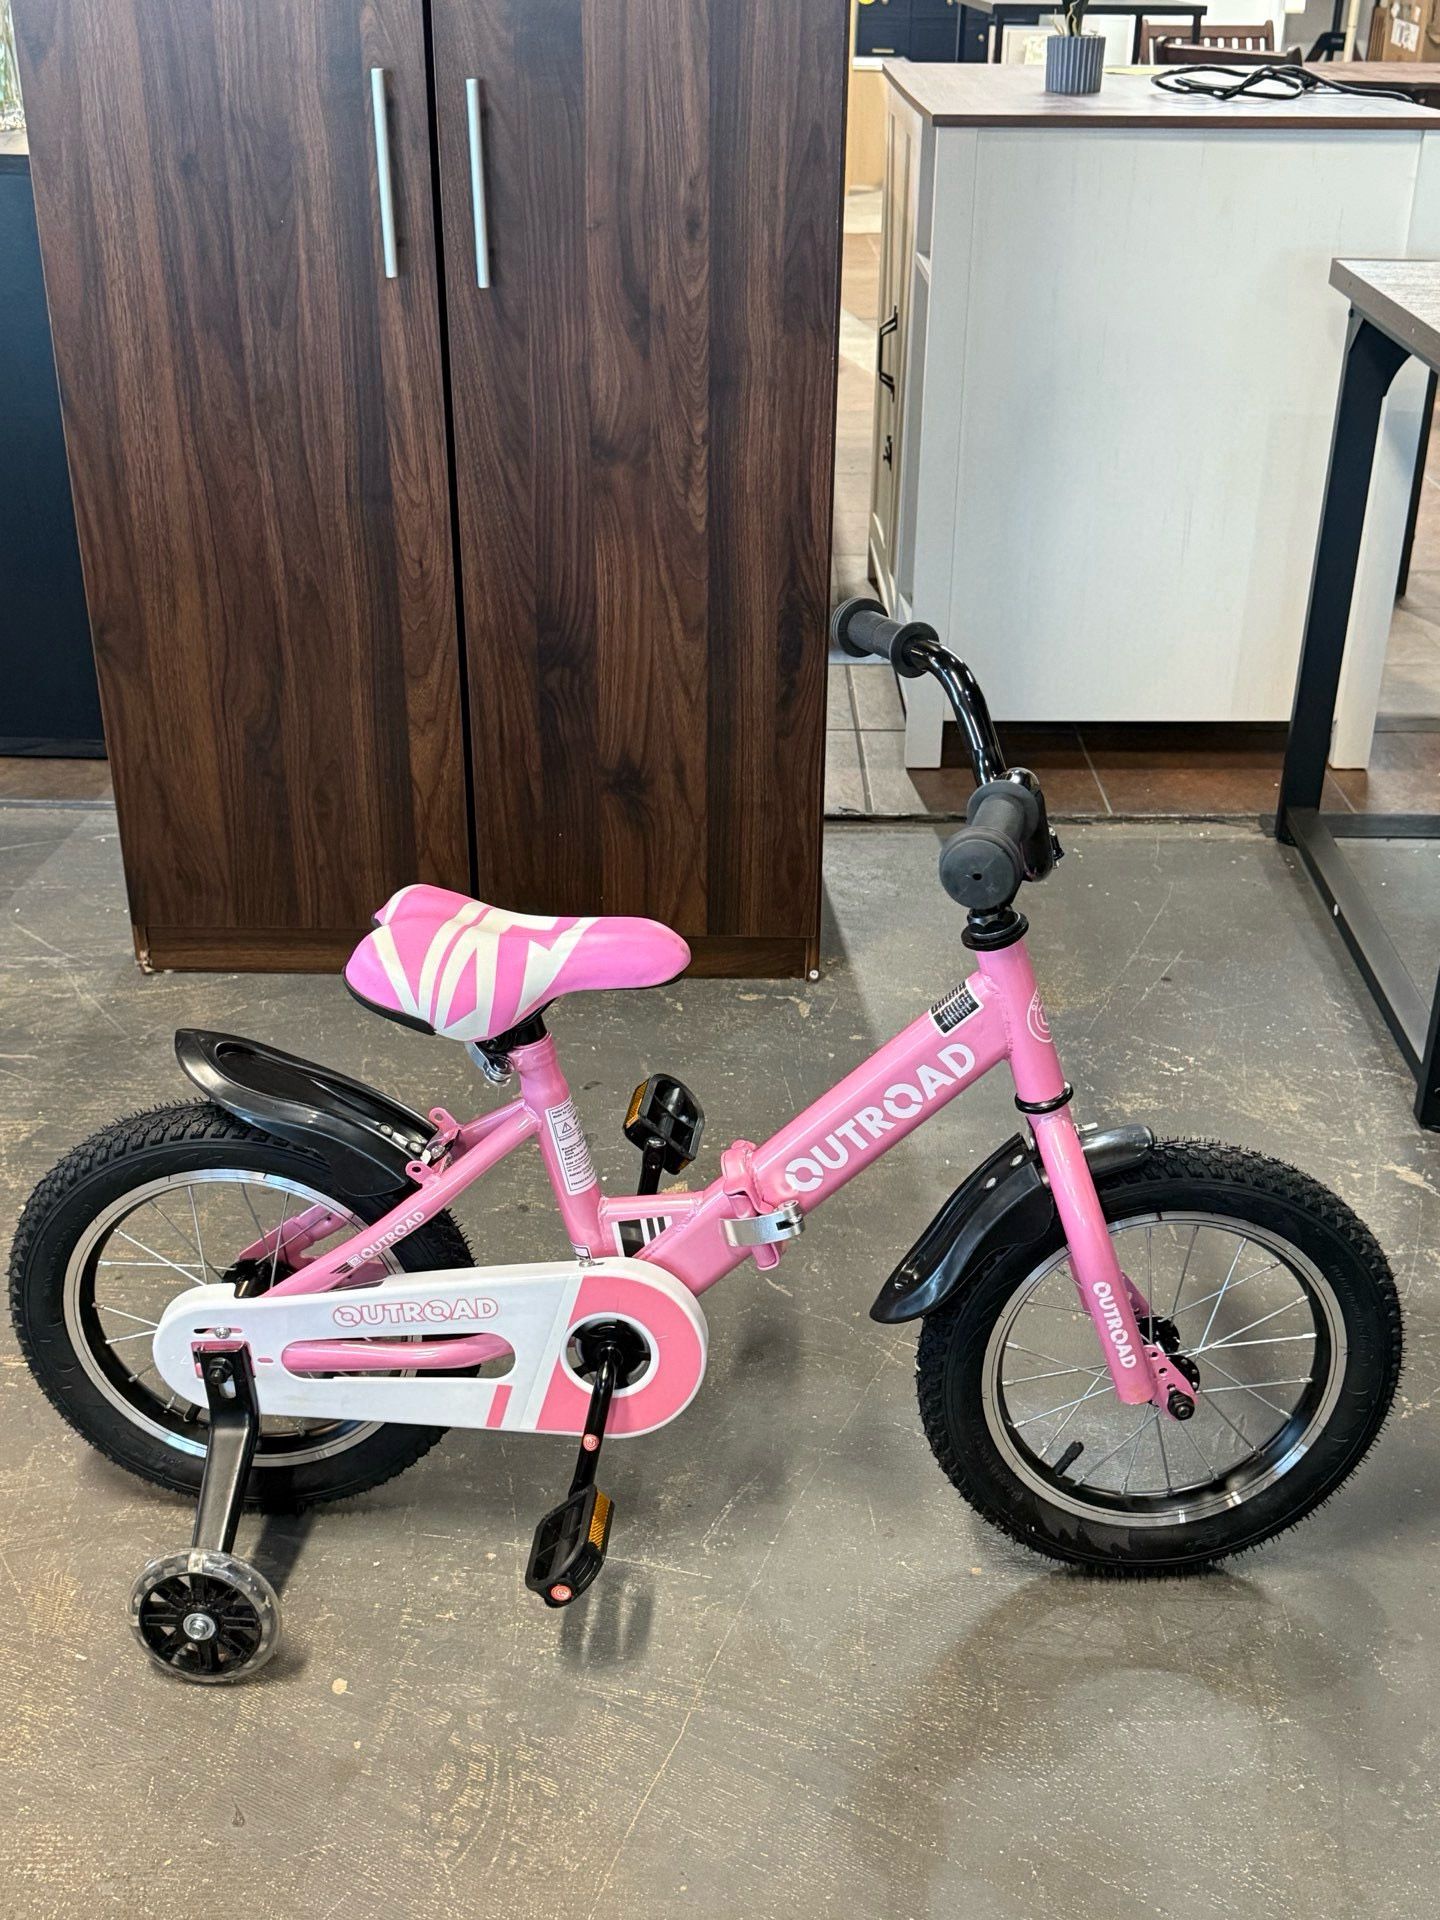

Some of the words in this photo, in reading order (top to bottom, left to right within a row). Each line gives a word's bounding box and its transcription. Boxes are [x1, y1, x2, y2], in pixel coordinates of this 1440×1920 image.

[785, 1043, 975, 1192] OUTROAD
[360, 1211, 425, 1259] OUTROAD
[333, 1298, 499, 1327] OUTROAD
[1092, 1281, 1137, 1368] OUTROAD
